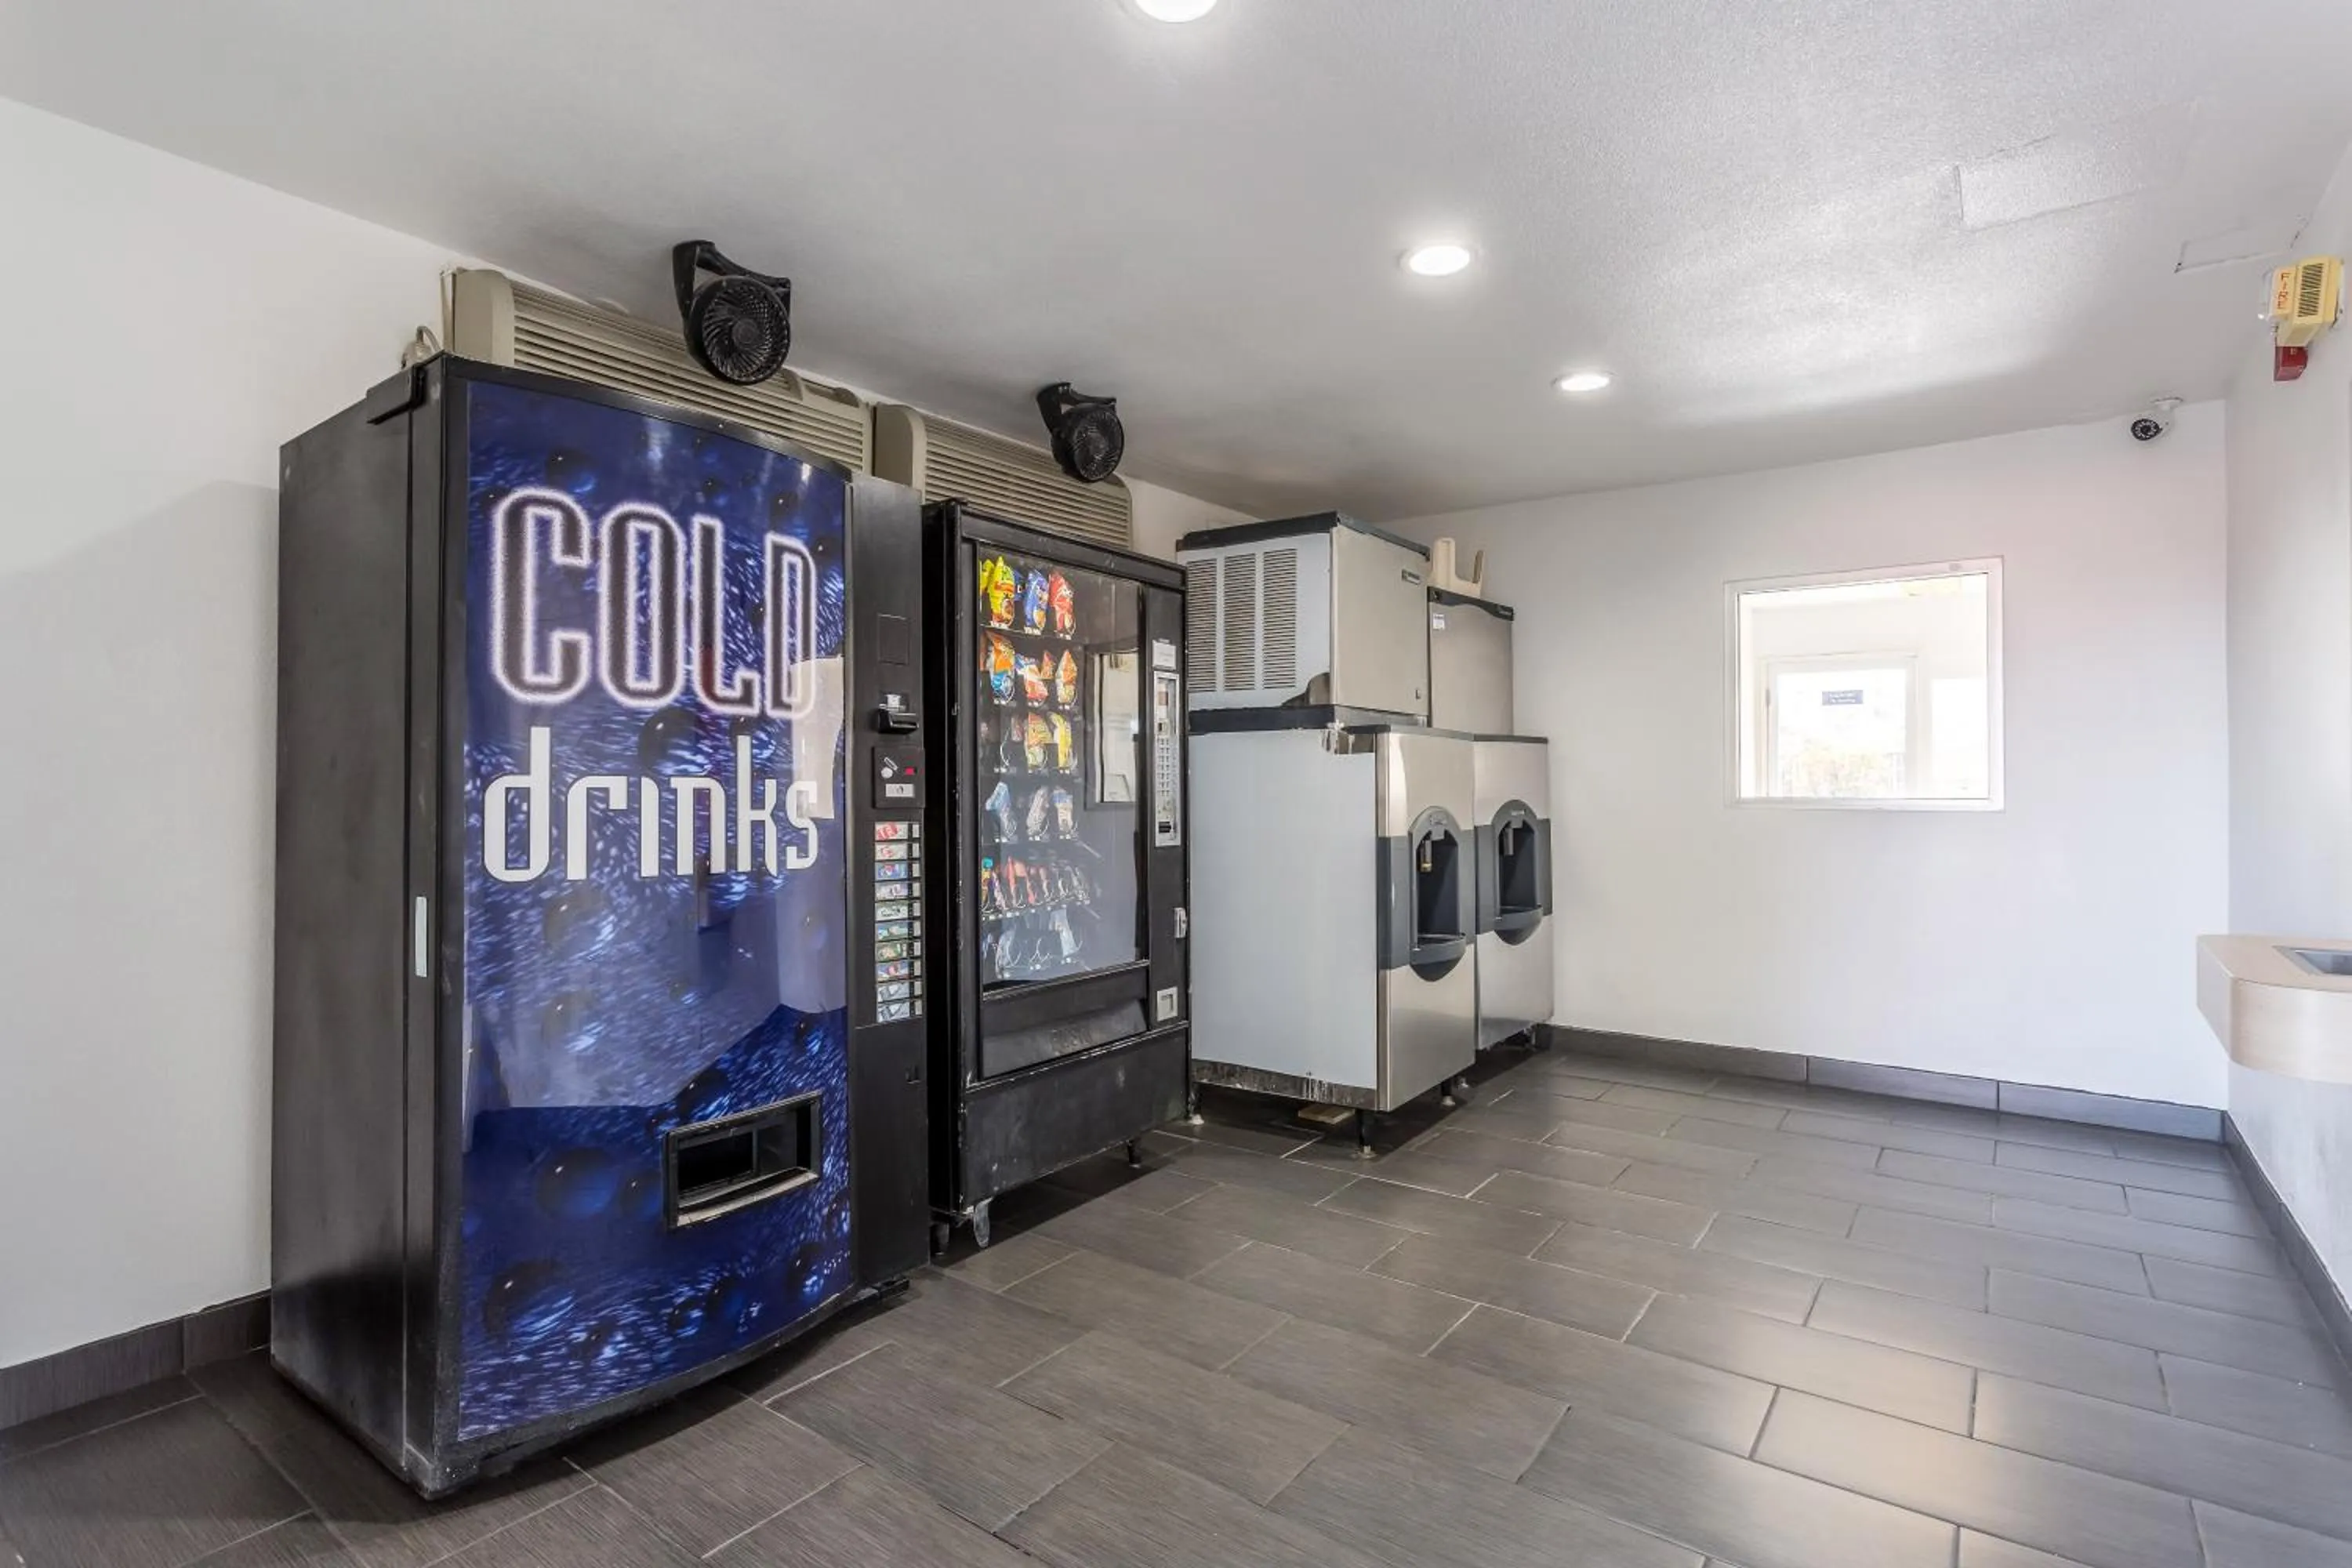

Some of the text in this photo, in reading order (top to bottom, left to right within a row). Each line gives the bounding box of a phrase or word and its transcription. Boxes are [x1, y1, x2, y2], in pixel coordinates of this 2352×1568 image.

[2277, 272, 2292, 309] FIRE
[492, 487, 817, 719] COLD
[484, 726, 818, 882] drinks
